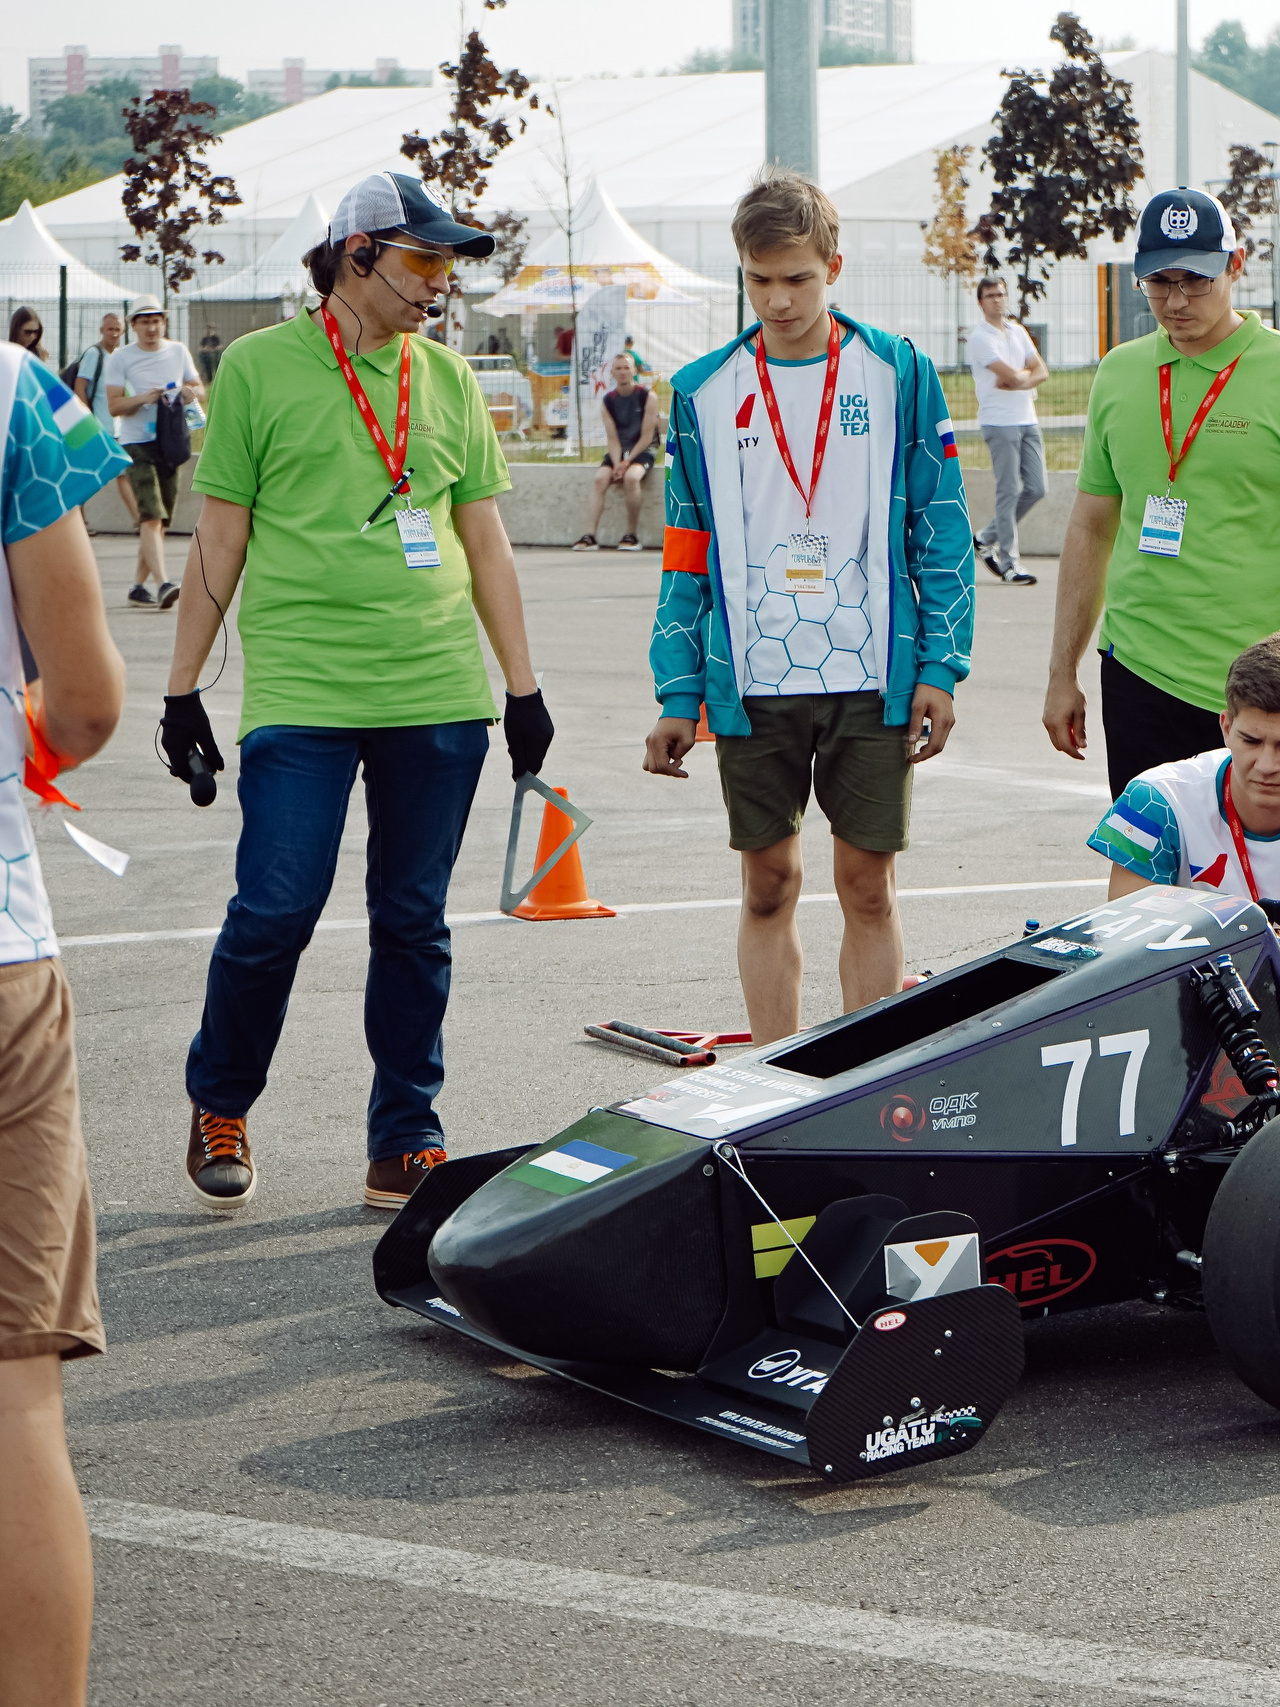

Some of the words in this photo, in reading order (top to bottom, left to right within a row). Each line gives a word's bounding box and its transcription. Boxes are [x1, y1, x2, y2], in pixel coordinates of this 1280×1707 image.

[840, 422, 869, 436] TEA
[1061, 908, 1211, 952] ГАТУ
[1040, 1028, 1150, 1147] 77
[930, 1091, 979, 1115] ОДК
[932, 1114, 977, 1131] УМПО
[987, 1263, 1073, 1295] HEL
[880, 1318, 901, 1329] HEL
[865, 1415, 936, 1451] UGATU
[865, 1441, 905, 1463] RACING
[906, 1435, 936, 1450] TEAM
